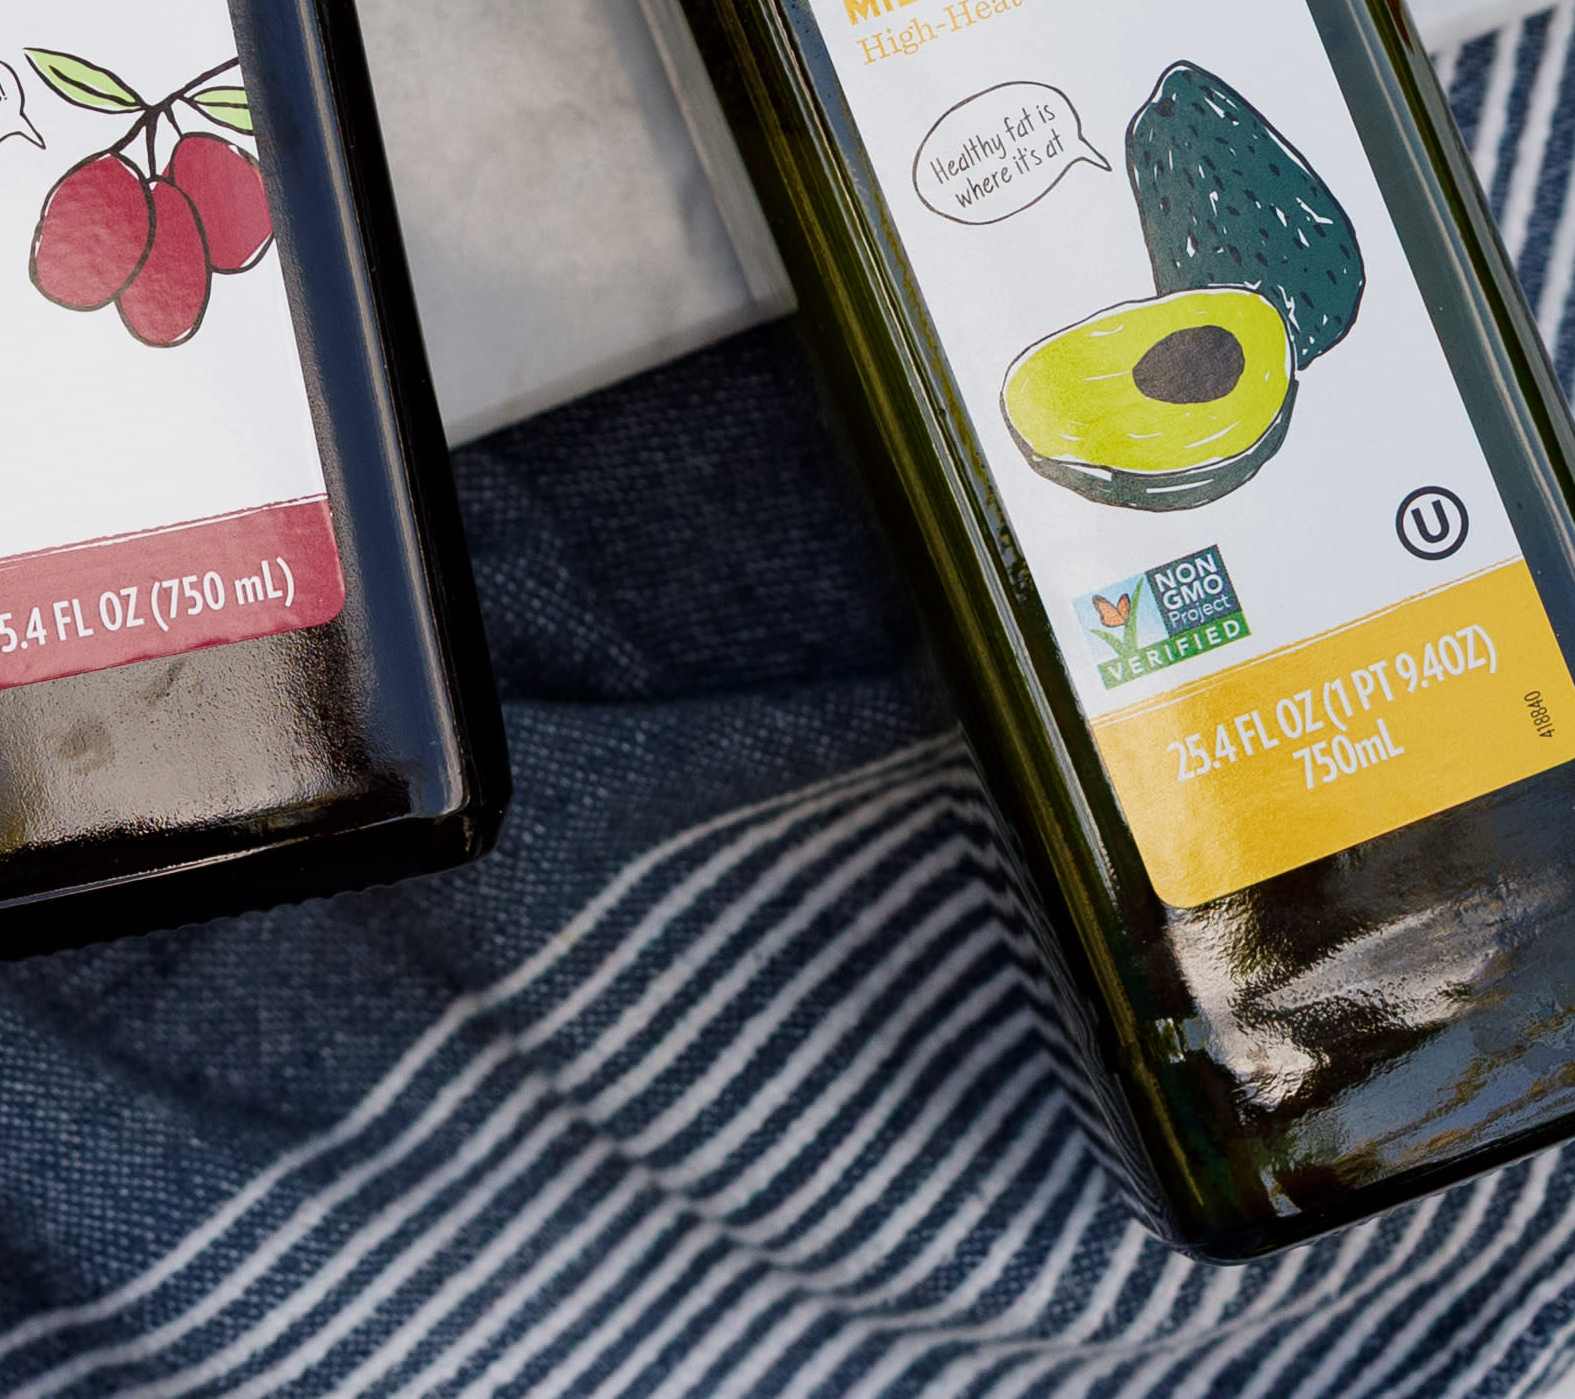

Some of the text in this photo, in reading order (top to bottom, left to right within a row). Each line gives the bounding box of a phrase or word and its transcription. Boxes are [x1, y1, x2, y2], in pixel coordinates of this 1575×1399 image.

[930, 104, 1055, 184] Healthy fat is
[955, 129, 1064, 208] where it's at
[54, 598, 92, 642] FL
[100, 586, 145, 631] OZ
[151, 571, 226, 631] (750
[233, 556, 295, 607] mL)
[1155, 553, 1218, 592] NON
[1163, 574, 1223, 610] GMO
[1169, 595, 1231, 628] Project
[1108, 620, 1240, 681] VERIFIED
[1166, 726, 1237, 782] 25.4
[1236, 710, 1278, 755] FL
[1276, 690, 1323, 739] OZ
[1351, 659, 1395, 711] PT
[1524, 691, 1555, 737] 418840
[1292, 718, 1405, 790] 750mL
